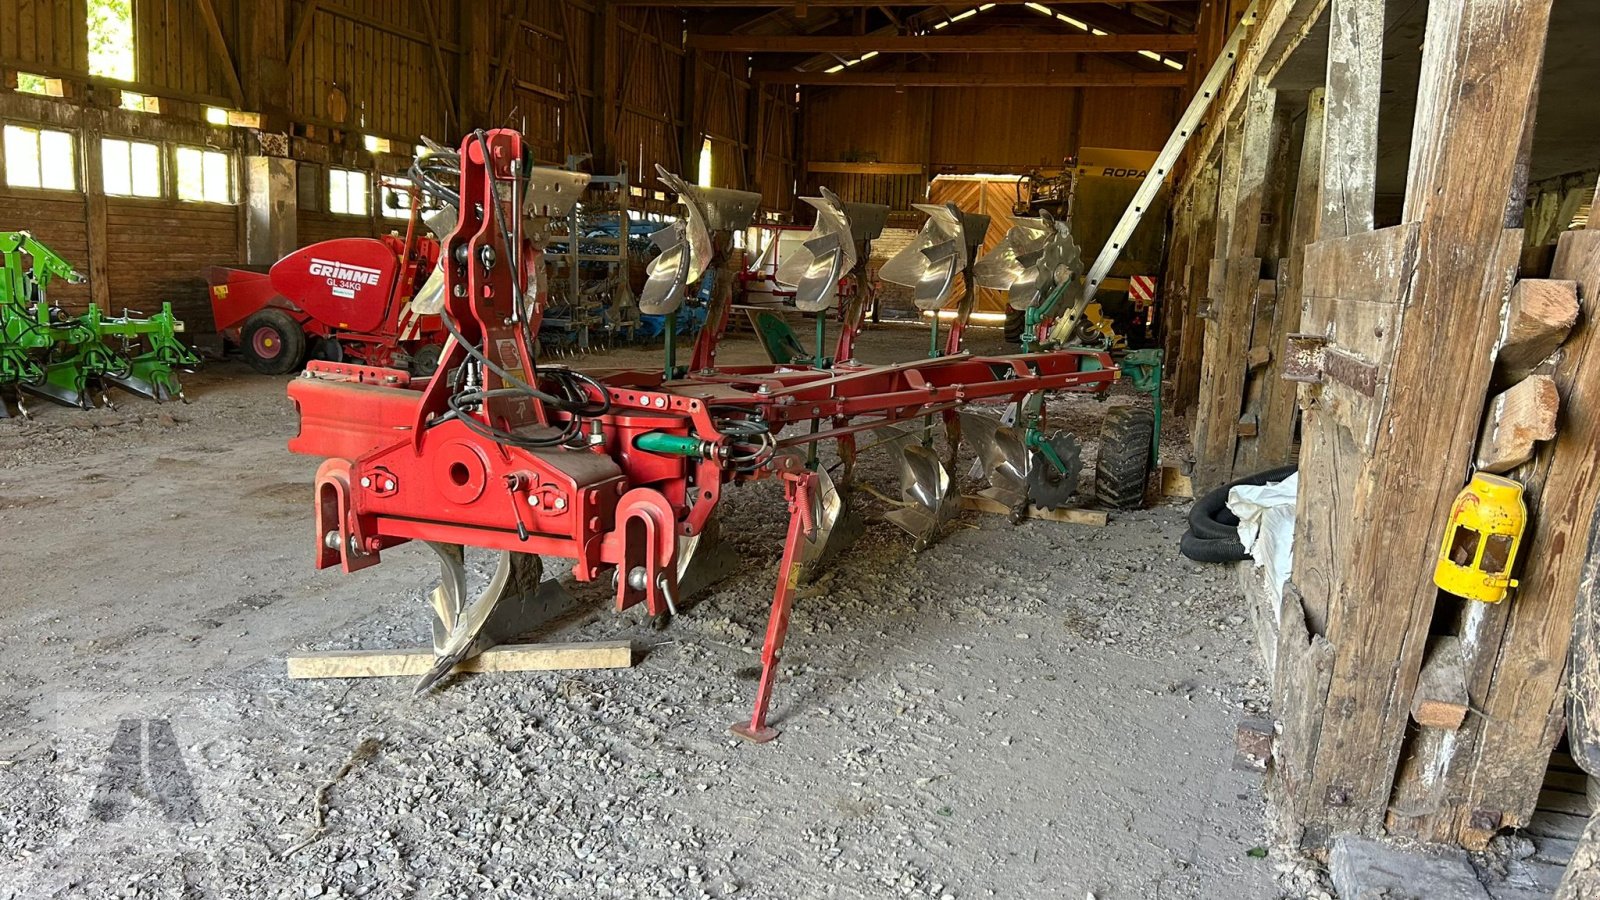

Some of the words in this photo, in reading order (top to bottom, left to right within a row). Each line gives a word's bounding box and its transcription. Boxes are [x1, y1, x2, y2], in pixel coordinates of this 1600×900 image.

[1102, 167, 1147, 179] ROPA
[309, 260, 380, 286] GRIMME
[326, 277, 338, 287] GL
[339, 280, 362, 291] 34KG
